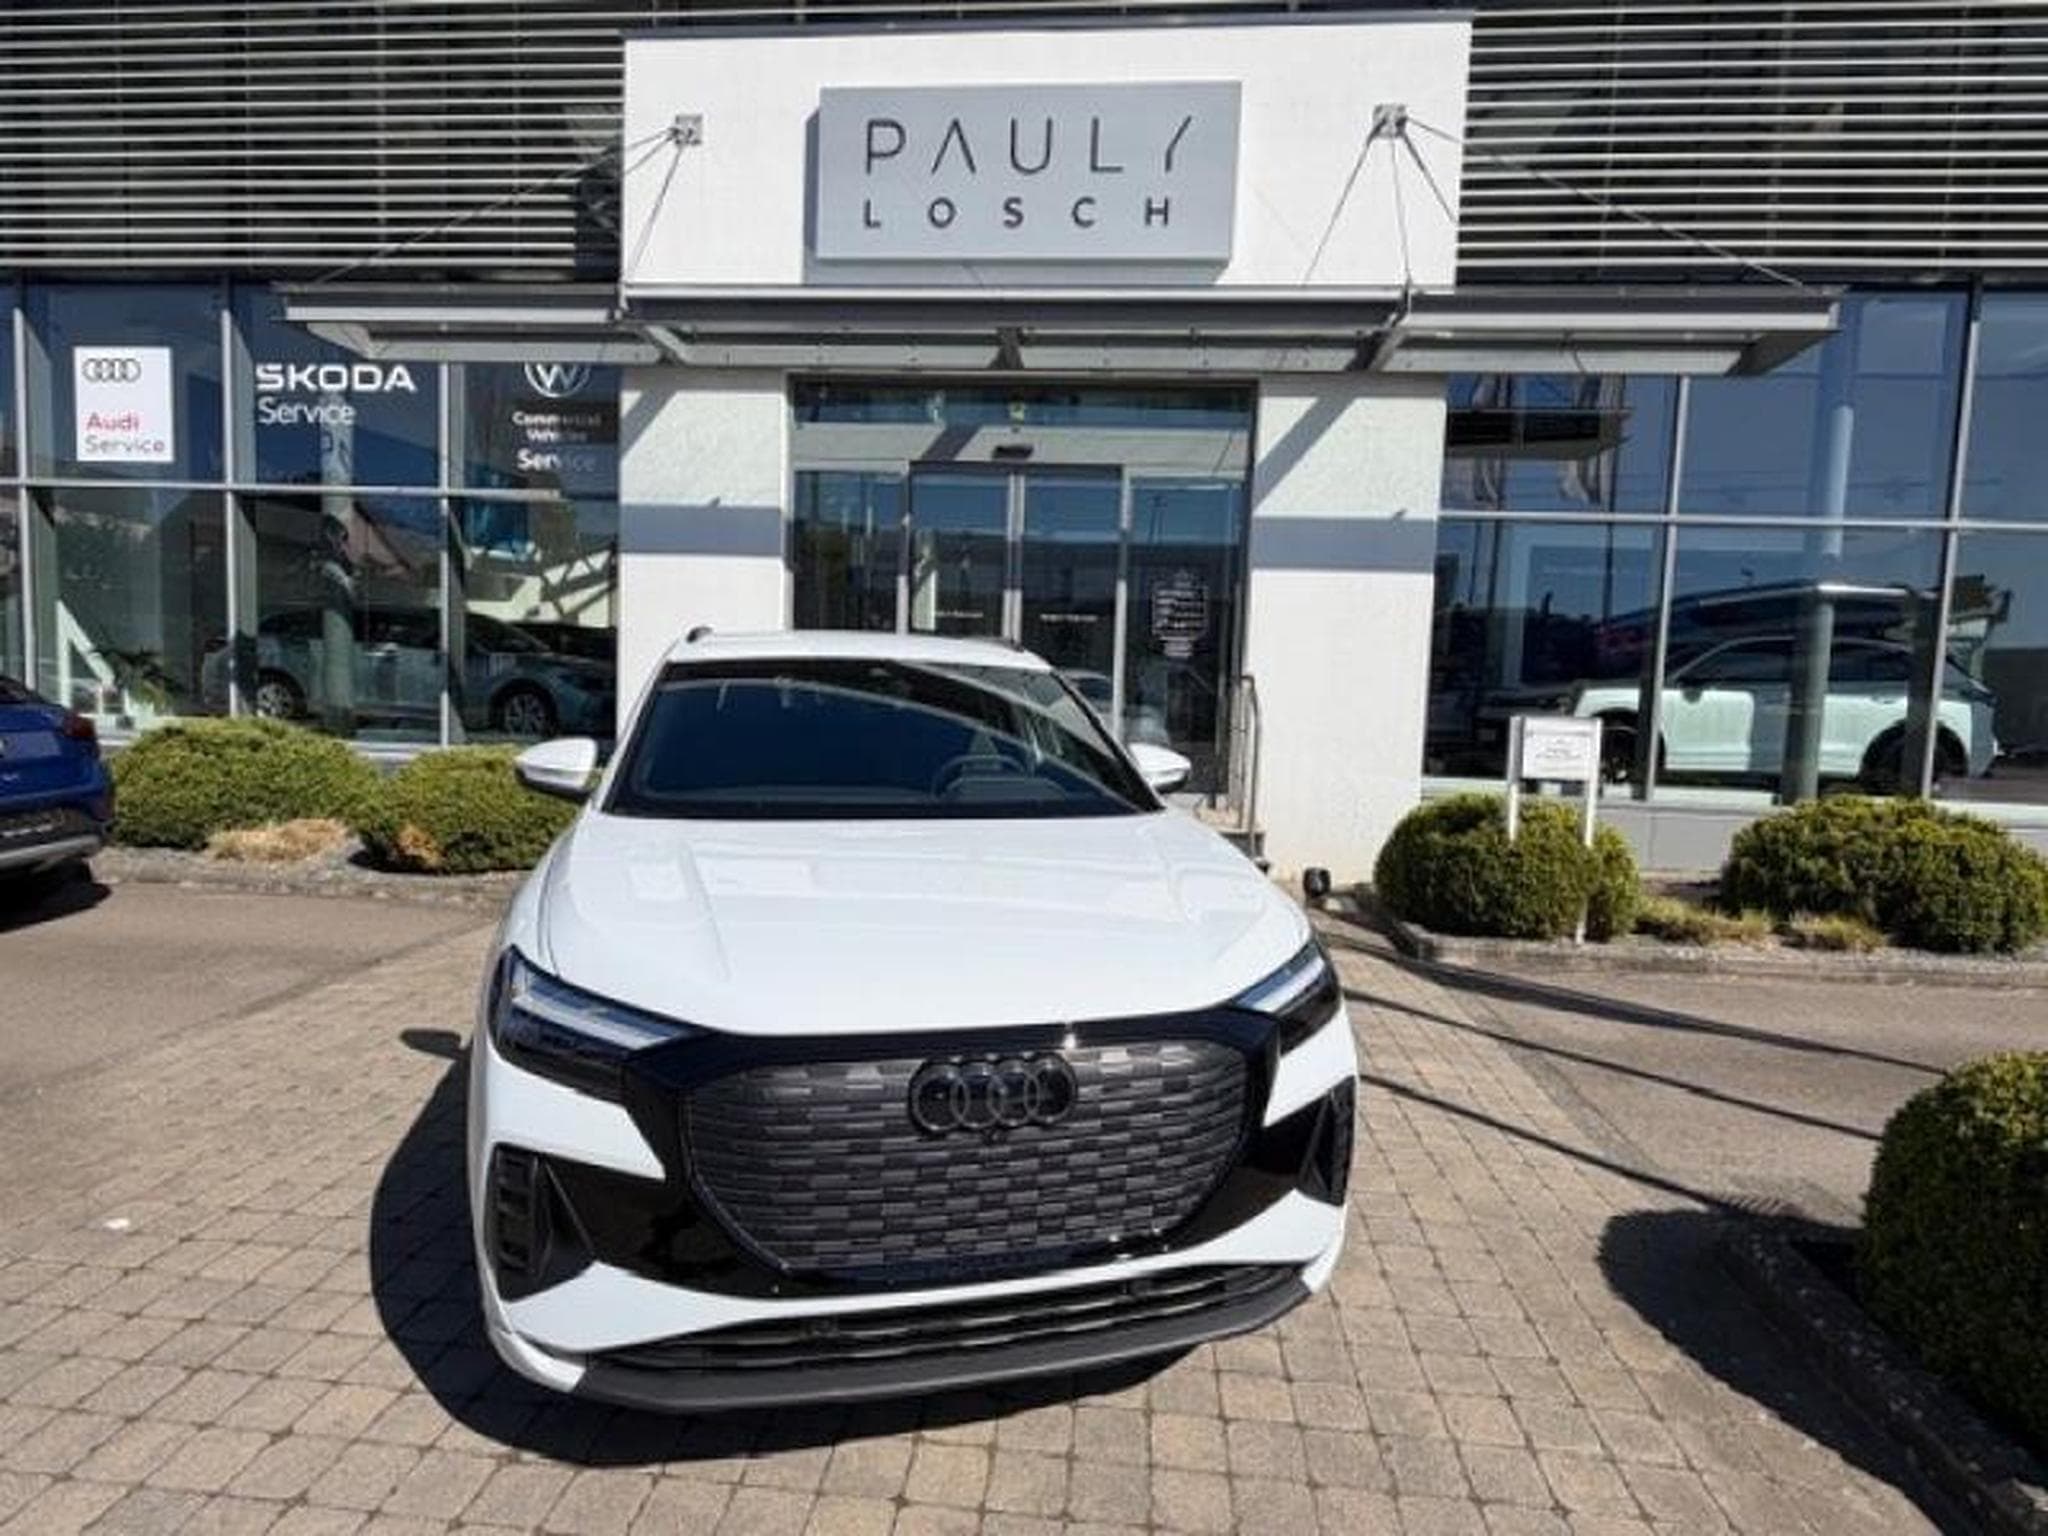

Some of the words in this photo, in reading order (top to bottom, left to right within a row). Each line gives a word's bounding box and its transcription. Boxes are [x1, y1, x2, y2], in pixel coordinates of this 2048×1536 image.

[863, 196, 1171, 230] LOSCH
[86, 411, 140, 431] Audi
[257, 395, 356, 425] Service
[84, 435, 165, 454] Service
